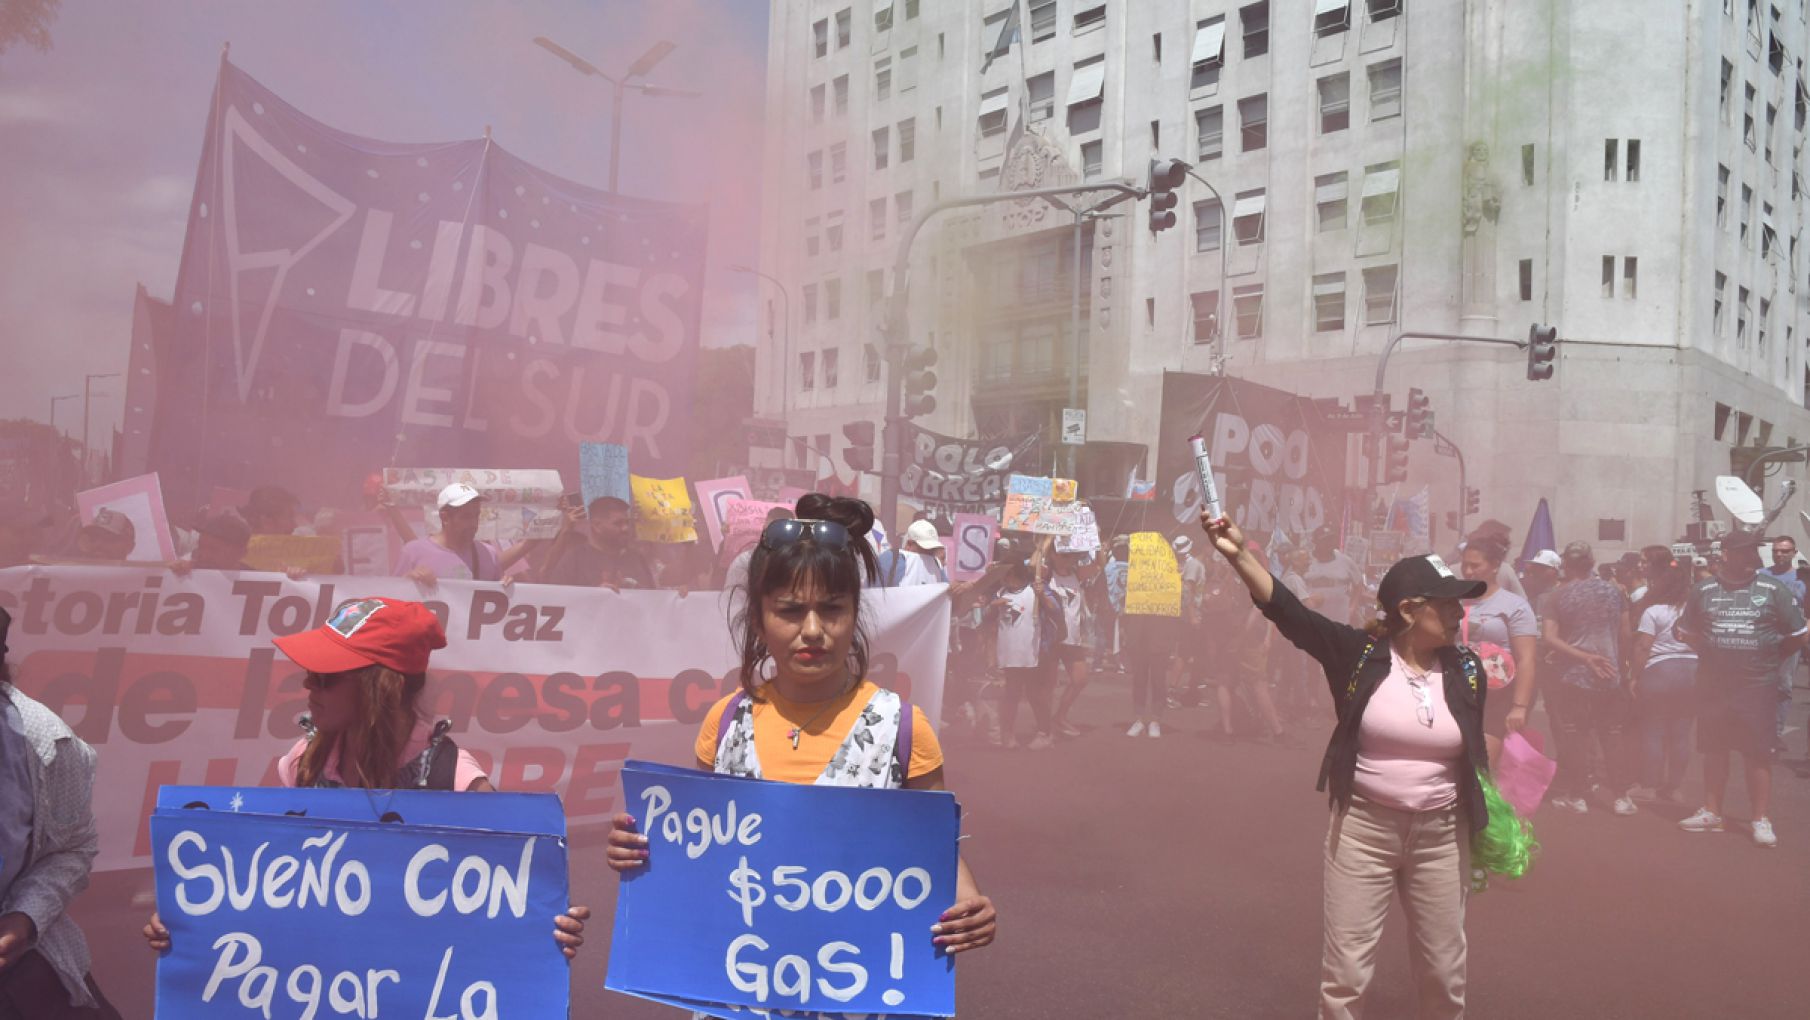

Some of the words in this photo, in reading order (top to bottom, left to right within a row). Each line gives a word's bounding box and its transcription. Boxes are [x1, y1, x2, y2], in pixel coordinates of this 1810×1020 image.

[347, 208, 688, 362] LIBRES
[326, 328, 488, 431] DEL
[510, 359, 671, 460] SUR
[386, 469, 477, 486] BASTA
[486, 470, 512, 485] DE
[914, 433, 1013, 475] POLO
[959, 525, 988, 570] S
[467, 590, 566, 641] Paz
[40, 647, 197, 745] de
[726, 856, 932, 926] $5000
